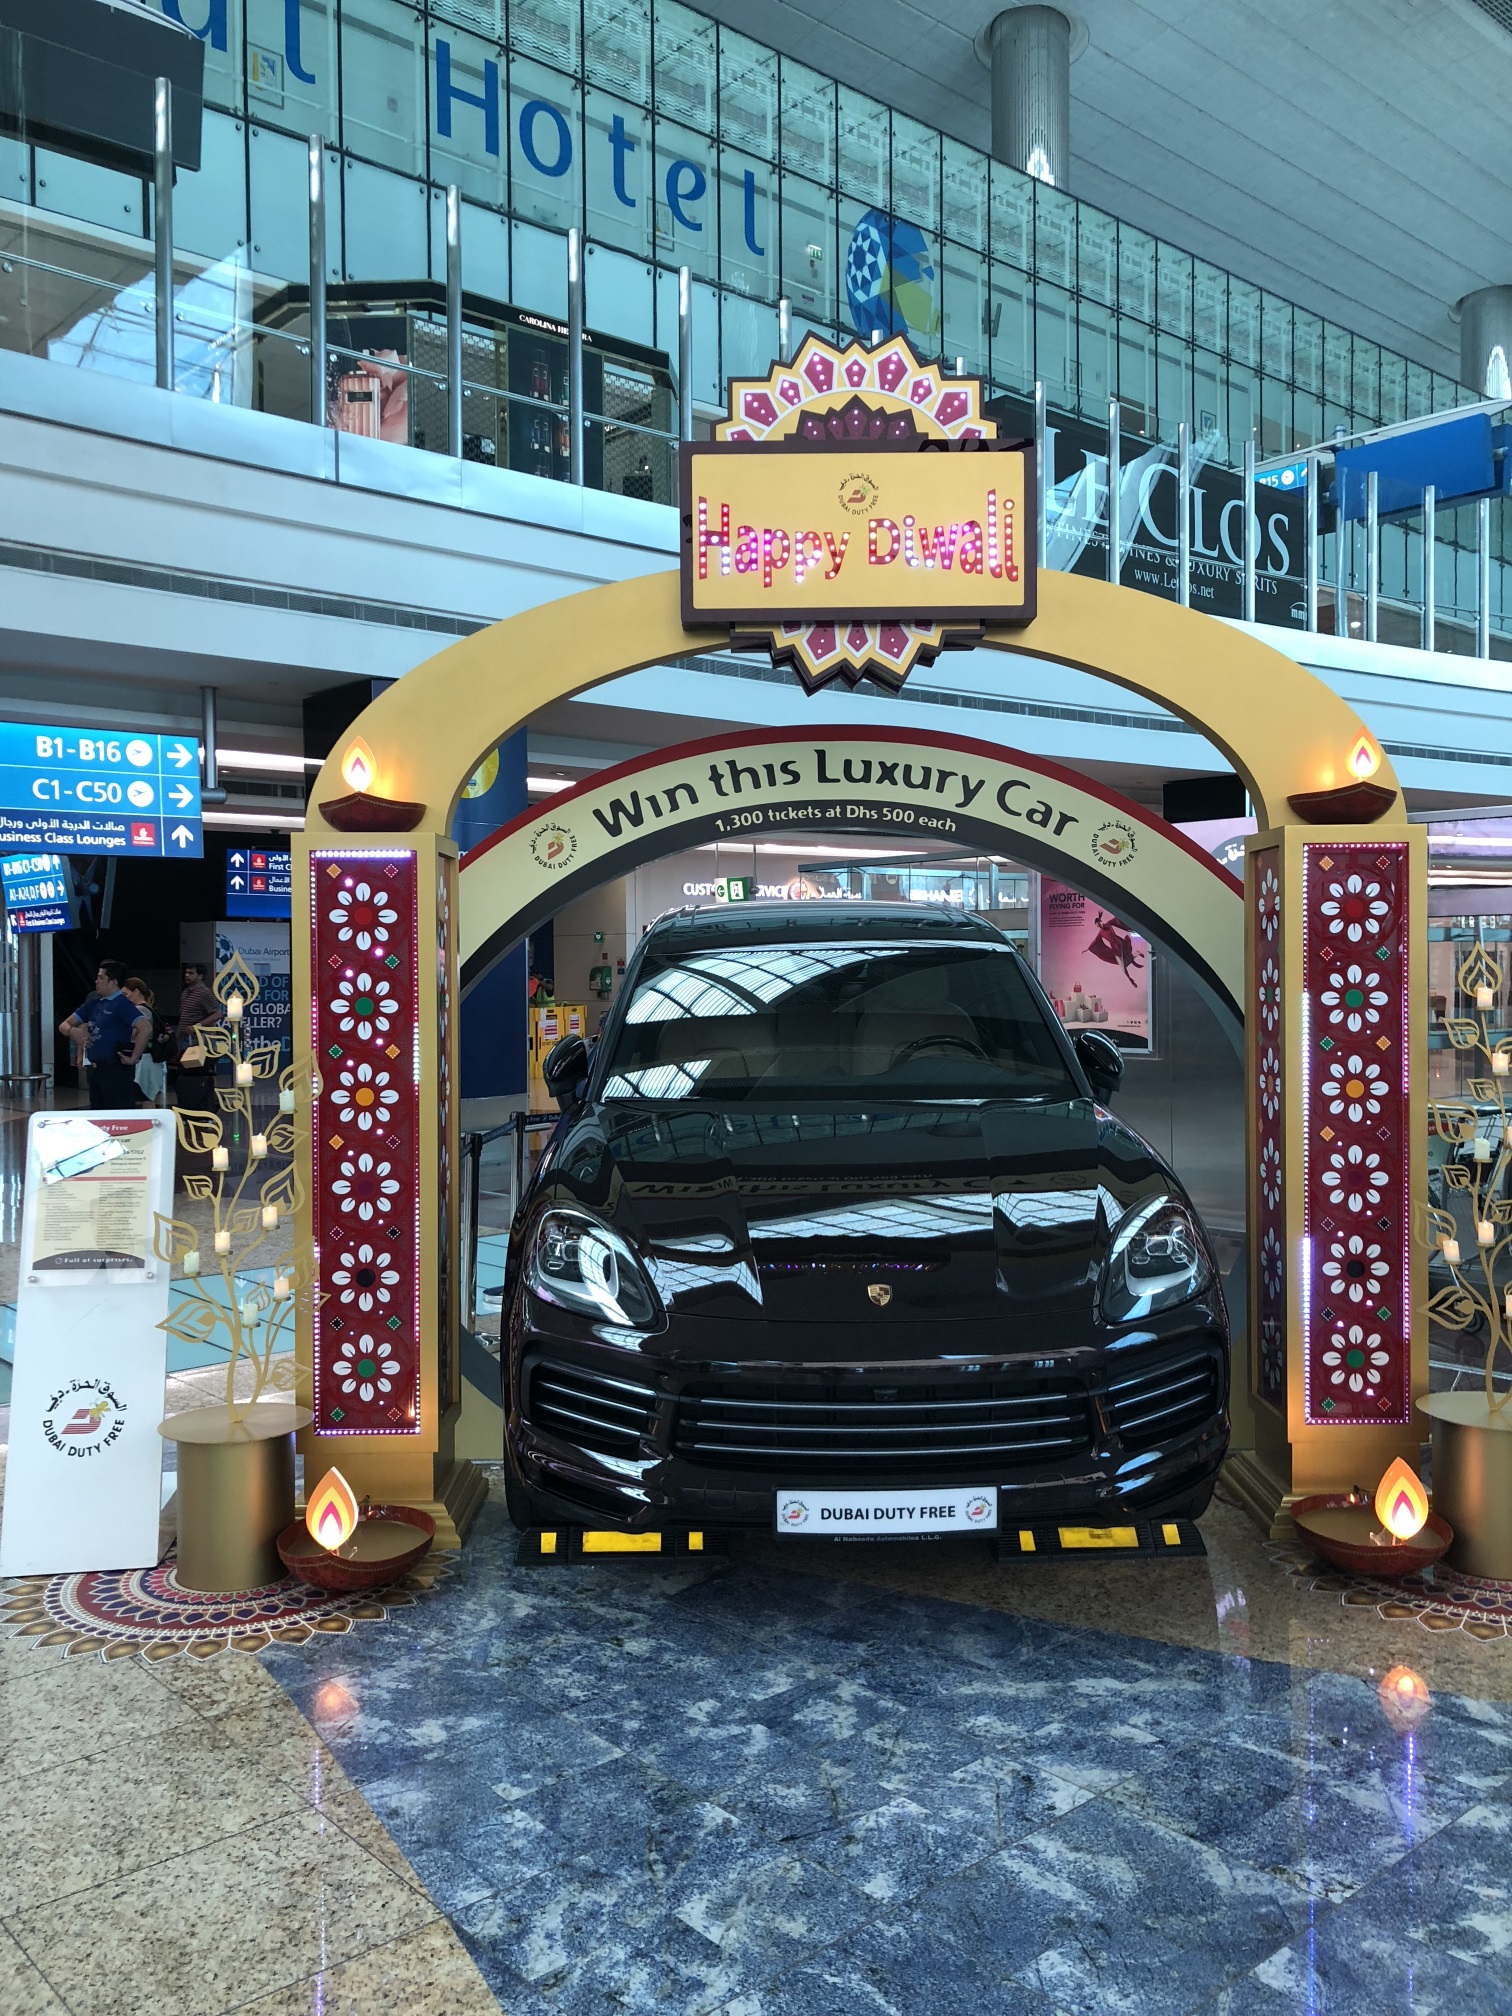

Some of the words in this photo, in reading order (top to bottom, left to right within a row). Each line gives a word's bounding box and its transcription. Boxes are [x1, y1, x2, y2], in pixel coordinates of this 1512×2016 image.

[436, 38, 765, 257] Hotel
[519, 314, 557, 332] CAROLINA
[557, 325, 593, 343] HERA
[838, 495, 850, 512] DUBAI
[869, 495, 878, 509] FREE
[698, 495, 851, 588] Happy
[868, 488, 1019, 582] Diwali
[1187, 560, 1230, 583] UXURY
[36, 735, 122, 763] B1-B16
[32, 778, 122, 804] C1-C50
[592, 782, 700, 838] Win
[708, 759, 801, 798] this
[813, 748, 986, 808] Luxury
[996, 778, 1080, 838] Car
[714, 809, 764, 833] 1,300
[768, 804, 821, 823] tickets
[826, 805, 841, 818] at
[846, 804, 878, 820] Dhs
[881, 807, 915, 824] 500
[918, 815, 957, 832] each
[44, 832, 75, 845] Class
[76, 833, 127, 849] Lounges
[1091, 833, 1100, 856] DUBAI
[1098, 856, 1116, 867] DUTY
[1119, 853, 1135, 867] FREE
[534, 855, 556, 869] DUBAI
[557, 853, 574, 868] DUTY
[569, 834, 577, 852] FREE
[268, 863, 284, 871] First
[268, 884, 292, 893] Busine
[683, 882, 716, 896] CUST
[1049, 892, 1085, 903] WORTH
[238, 947, 262, 955] Dubai
[272, 976, 289, 988] OF
[265, 989, 289, 1001] FOR
[250, 1003, 290, 1015] GLOBA
[43, 1419, 66, 1451] DUBAI
[68, 1443, 101, 1457] DUTY
[103, 1419, 125, 1447] FREE
[820, 1507, 869, 1520] DUBAI
[873, 1507, 916, 1520] DUTY
[920, 1505, 956, 1519] FREE
